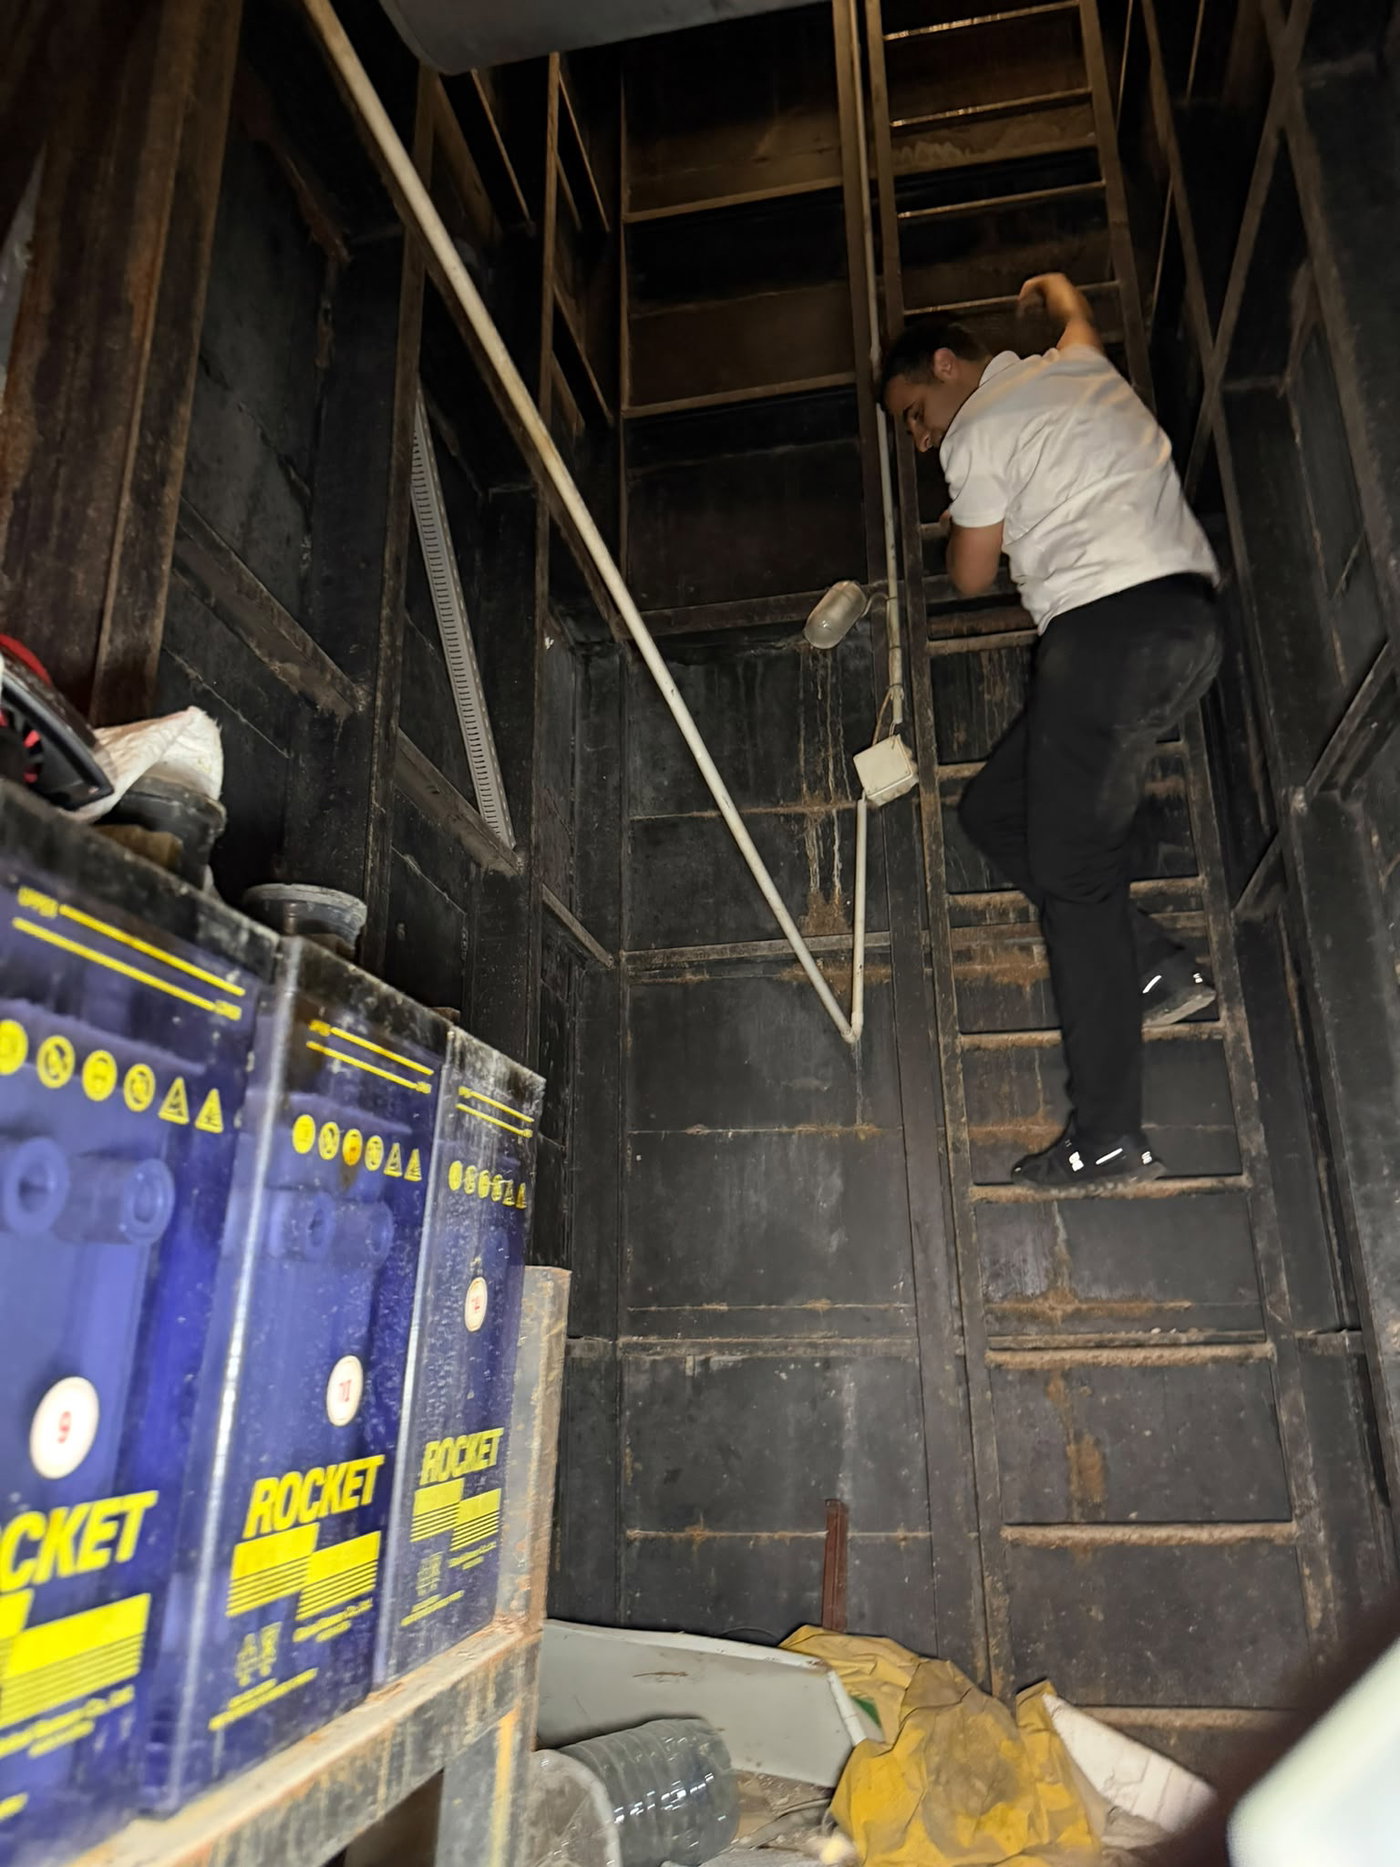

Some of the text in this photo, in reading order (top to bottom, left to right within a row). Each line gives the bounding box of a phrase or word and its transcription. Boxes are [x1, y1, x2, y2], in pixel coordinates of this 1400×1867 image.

[57, 1411, 72, 1443] 9
[420, 1427, 505, 1485] ROCKET
[242, 1454, 386, 1539] ROCKET
[0, 1490, 159, 1592] CKET
